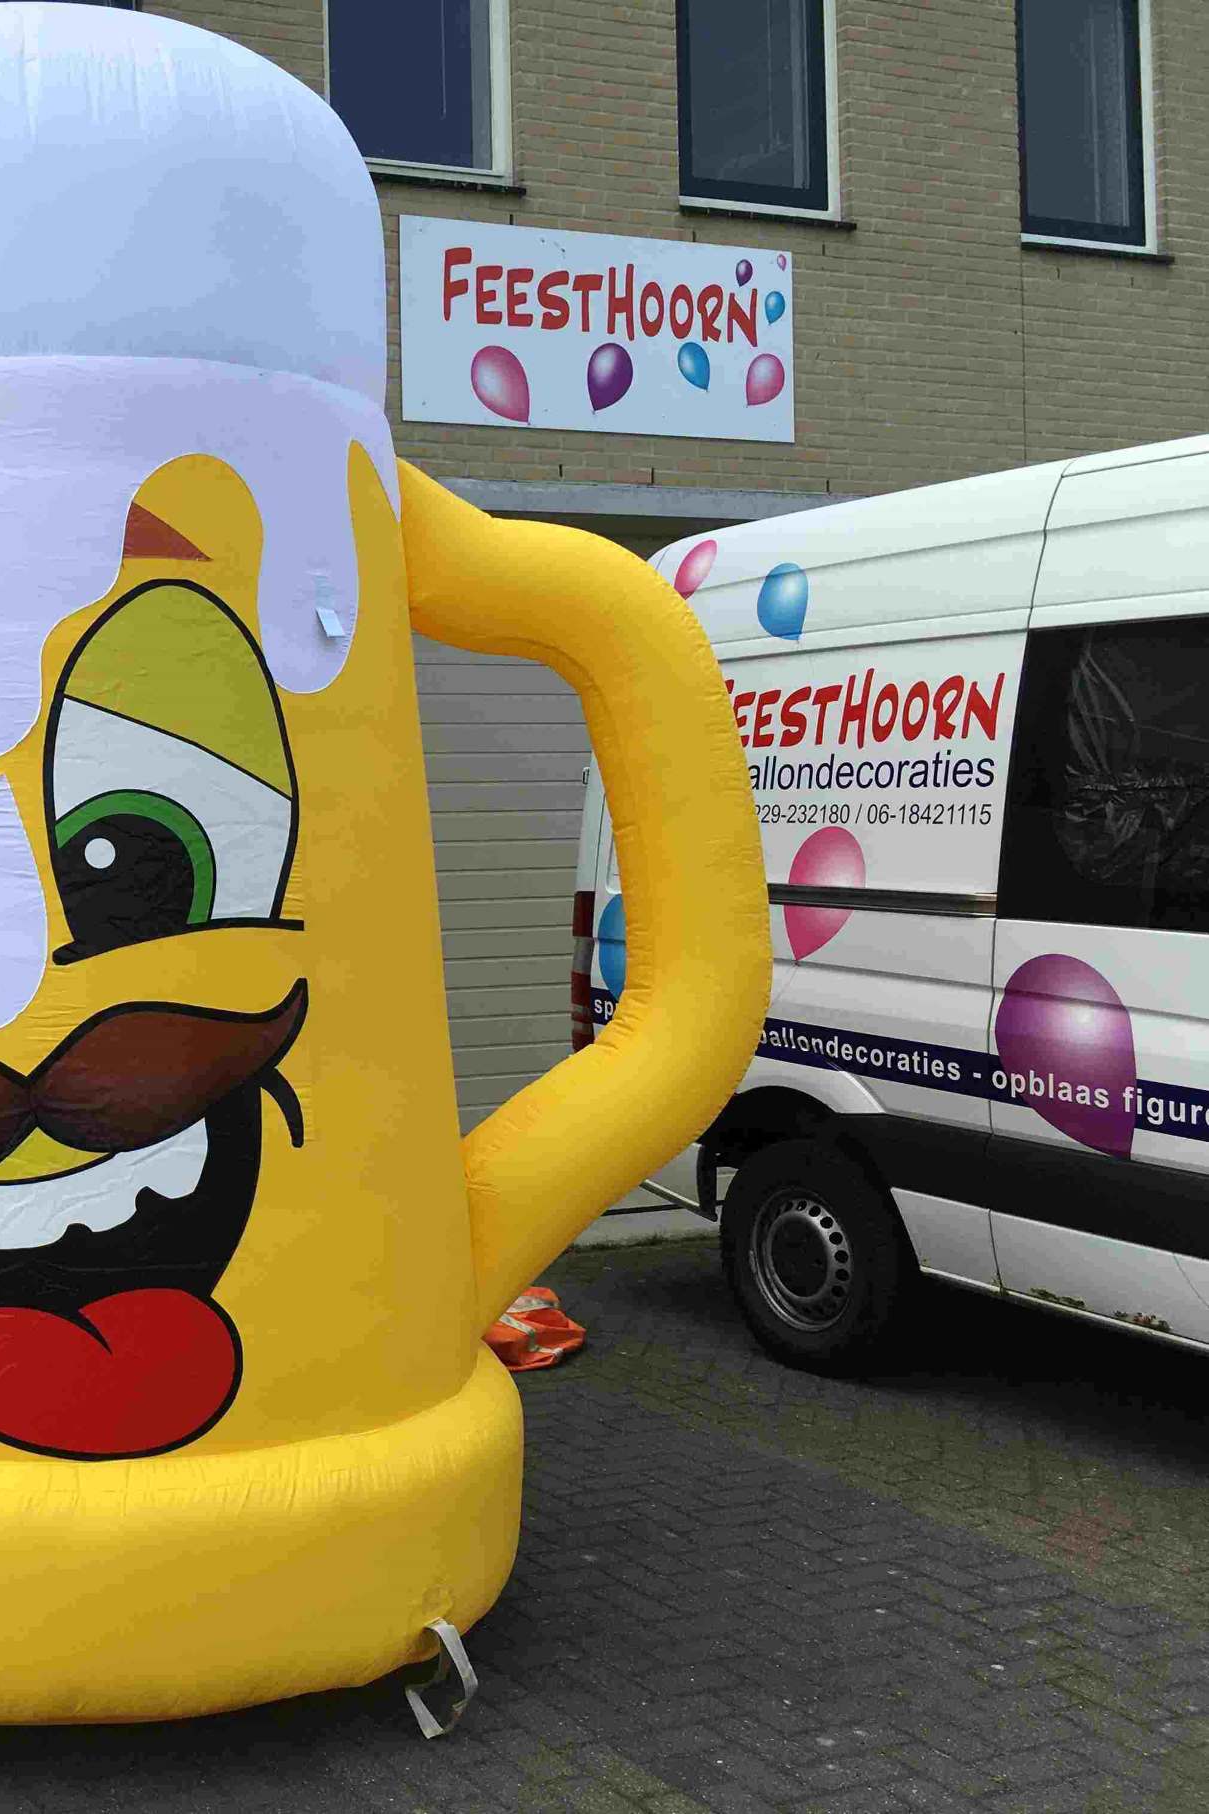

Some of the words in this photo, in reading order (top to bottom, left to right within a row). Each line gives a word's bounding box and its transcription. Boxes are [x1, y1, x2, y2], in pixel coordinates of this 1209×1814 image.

[443, 246, 758, 347] FEESTHOORN
[725, 667, 1005, 749] EESTHOORN
[855, 804, 862, 824] /
[867, 803, 992, 825] 06-18421115
[992, 1070, 1110, 1109] opblaas
